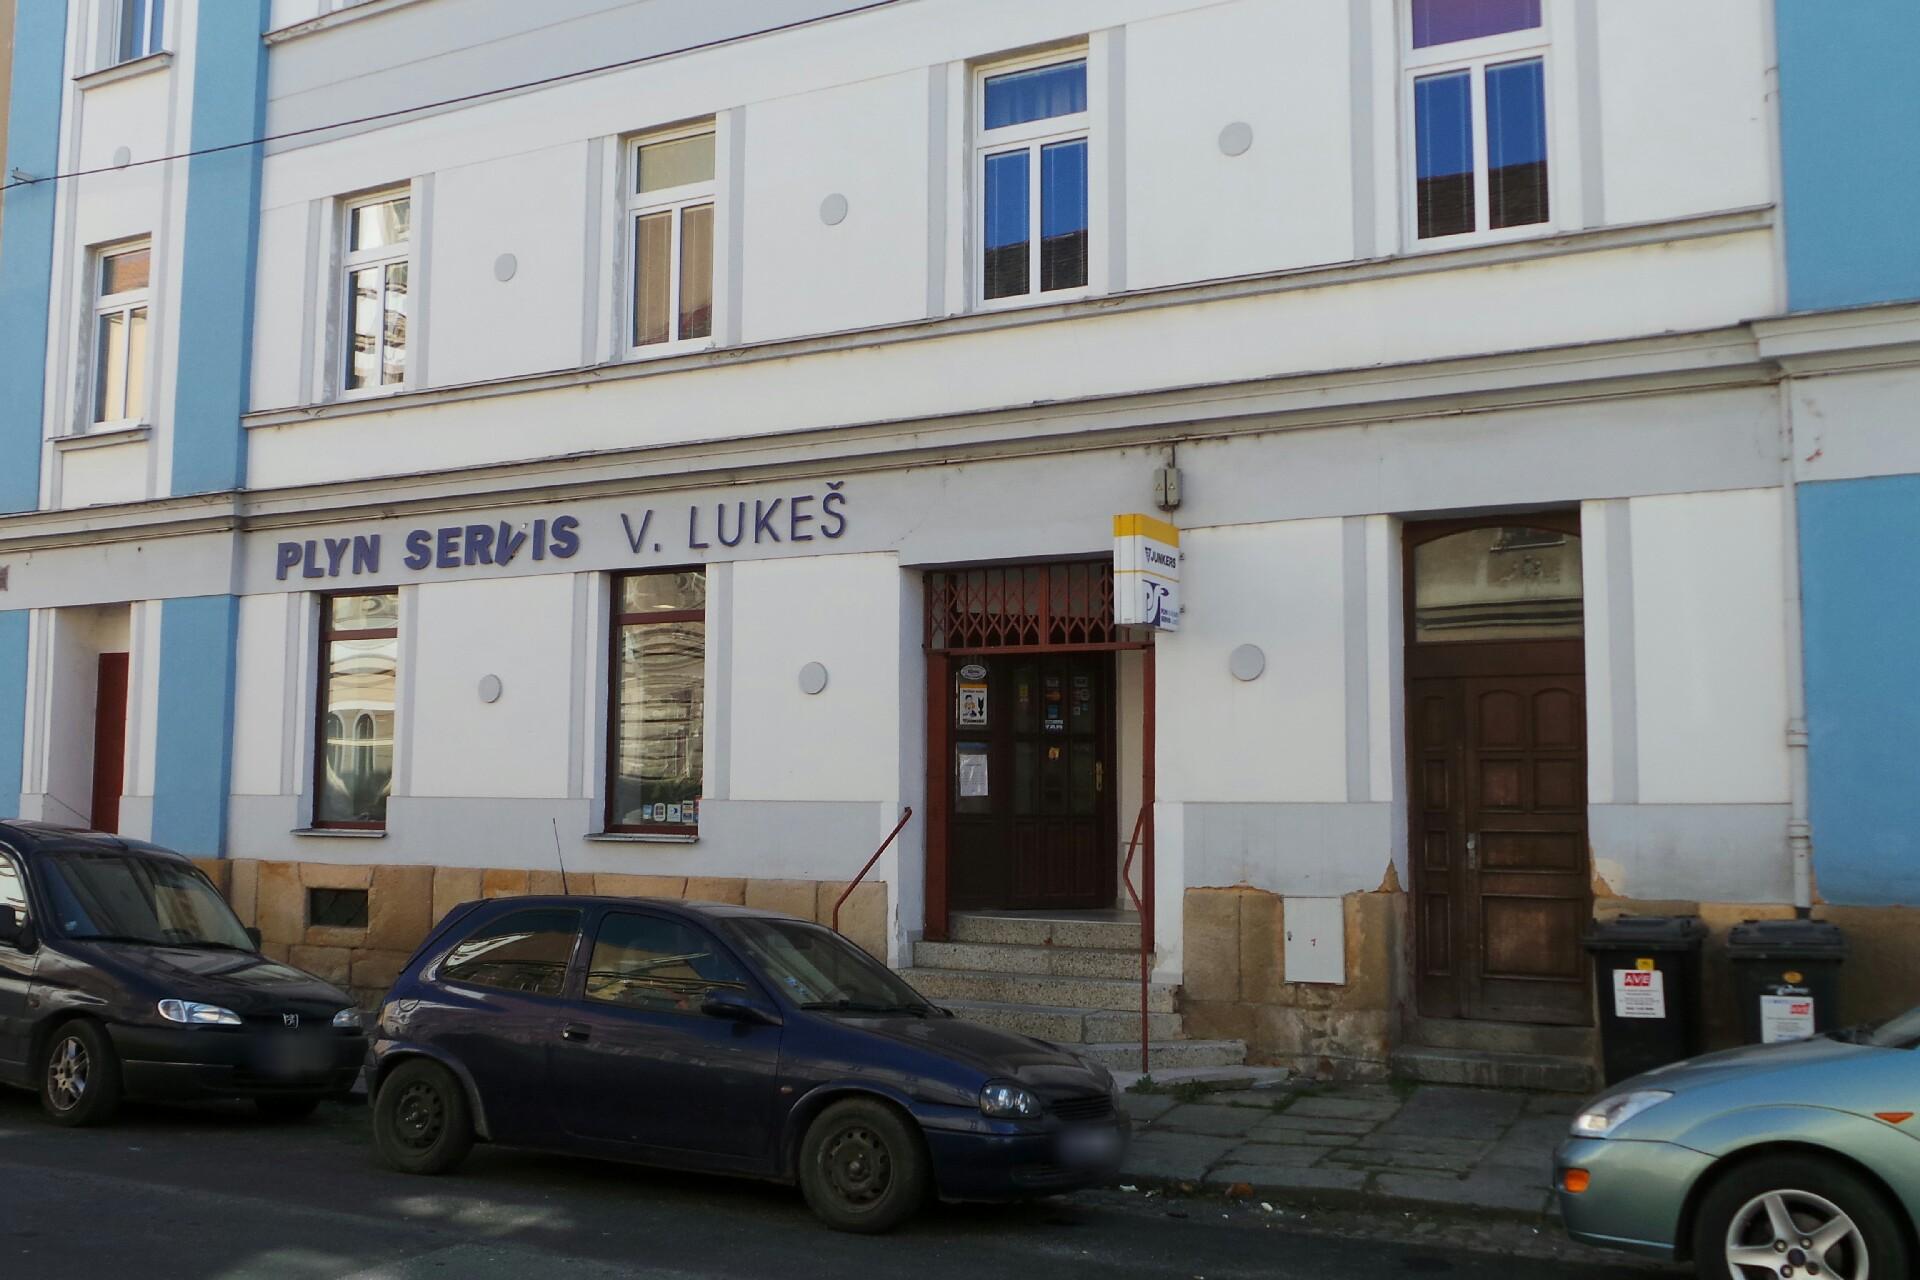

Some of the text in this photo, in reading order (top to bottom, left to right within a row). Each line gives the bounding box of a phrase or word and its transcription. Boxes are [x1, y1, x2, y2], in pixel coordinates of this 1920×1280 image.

[276, 480, 846, 580] PLYN SERVIS V. LUKEŠ
[1151, 551, 1177, 568] JUNKERS
[1625, 973, 1650, 985] AVE
